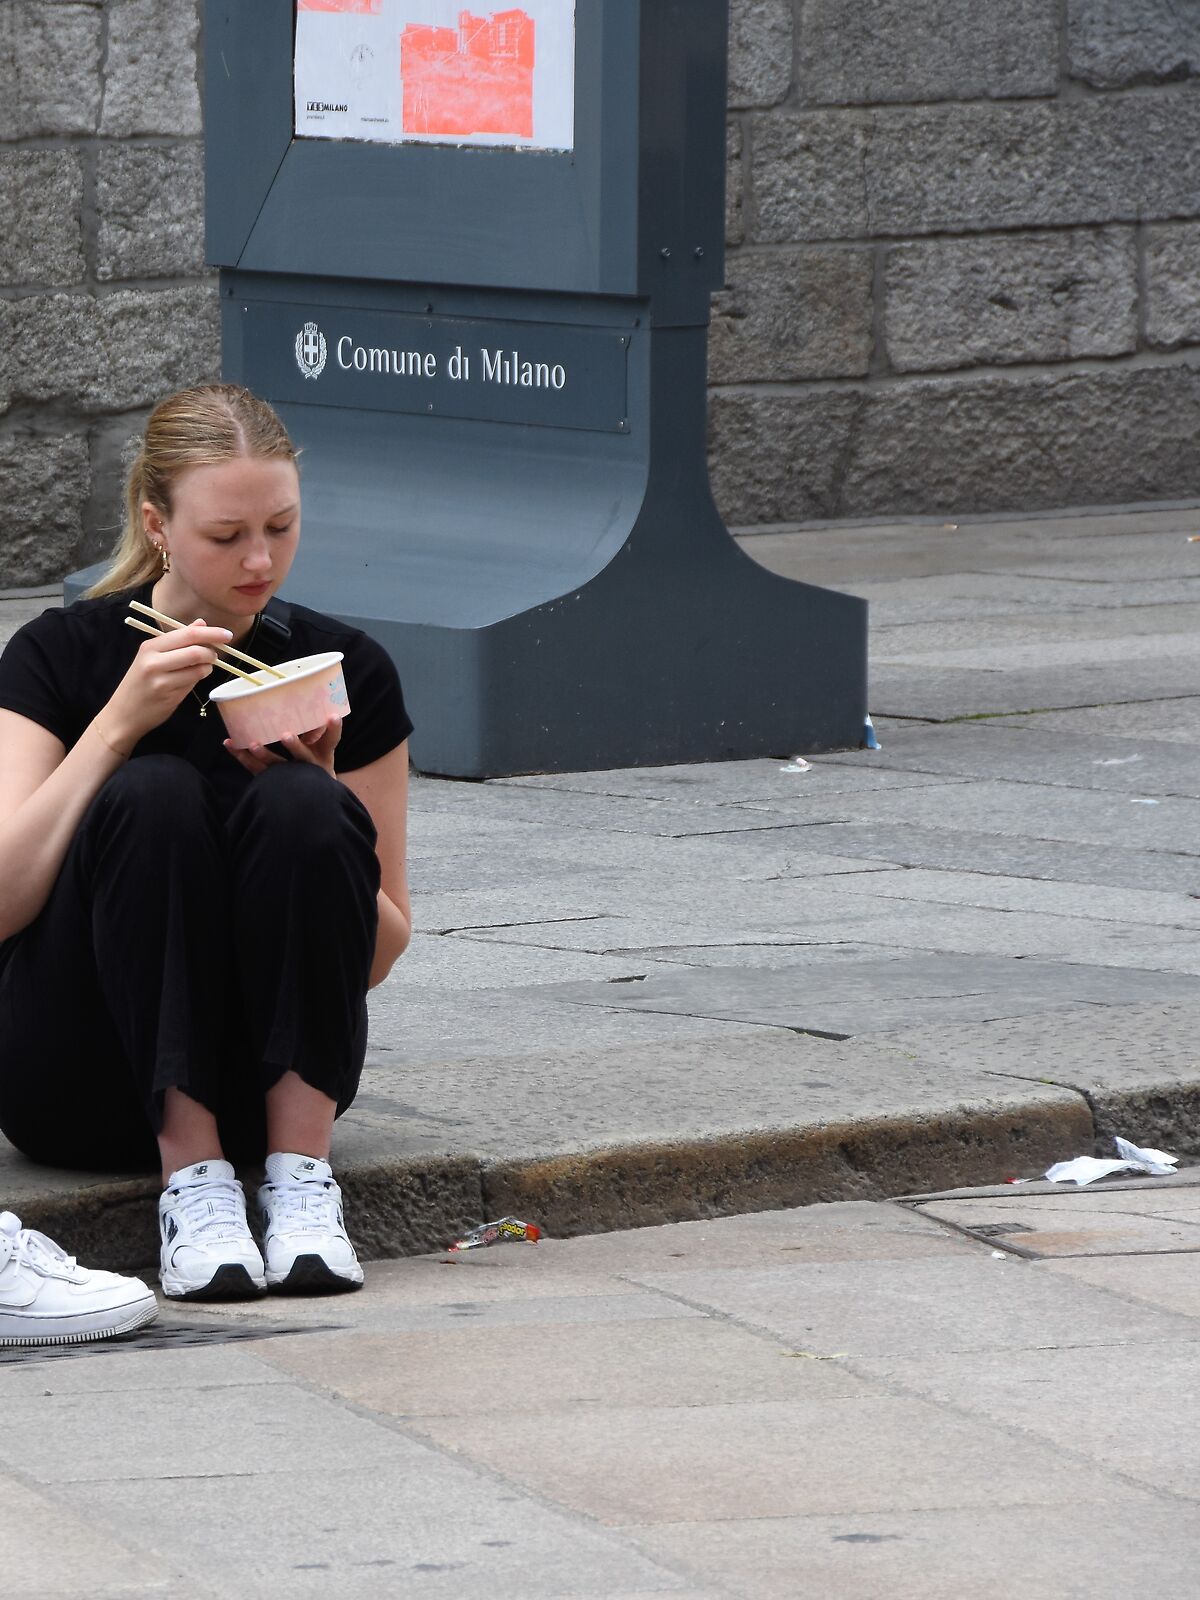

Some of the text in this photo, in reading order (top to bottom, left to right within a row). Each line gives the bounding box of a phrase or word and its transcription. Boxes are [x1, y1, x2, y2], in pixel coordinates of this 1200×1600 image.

[337, 336, 566, 389] Comune di Milano
